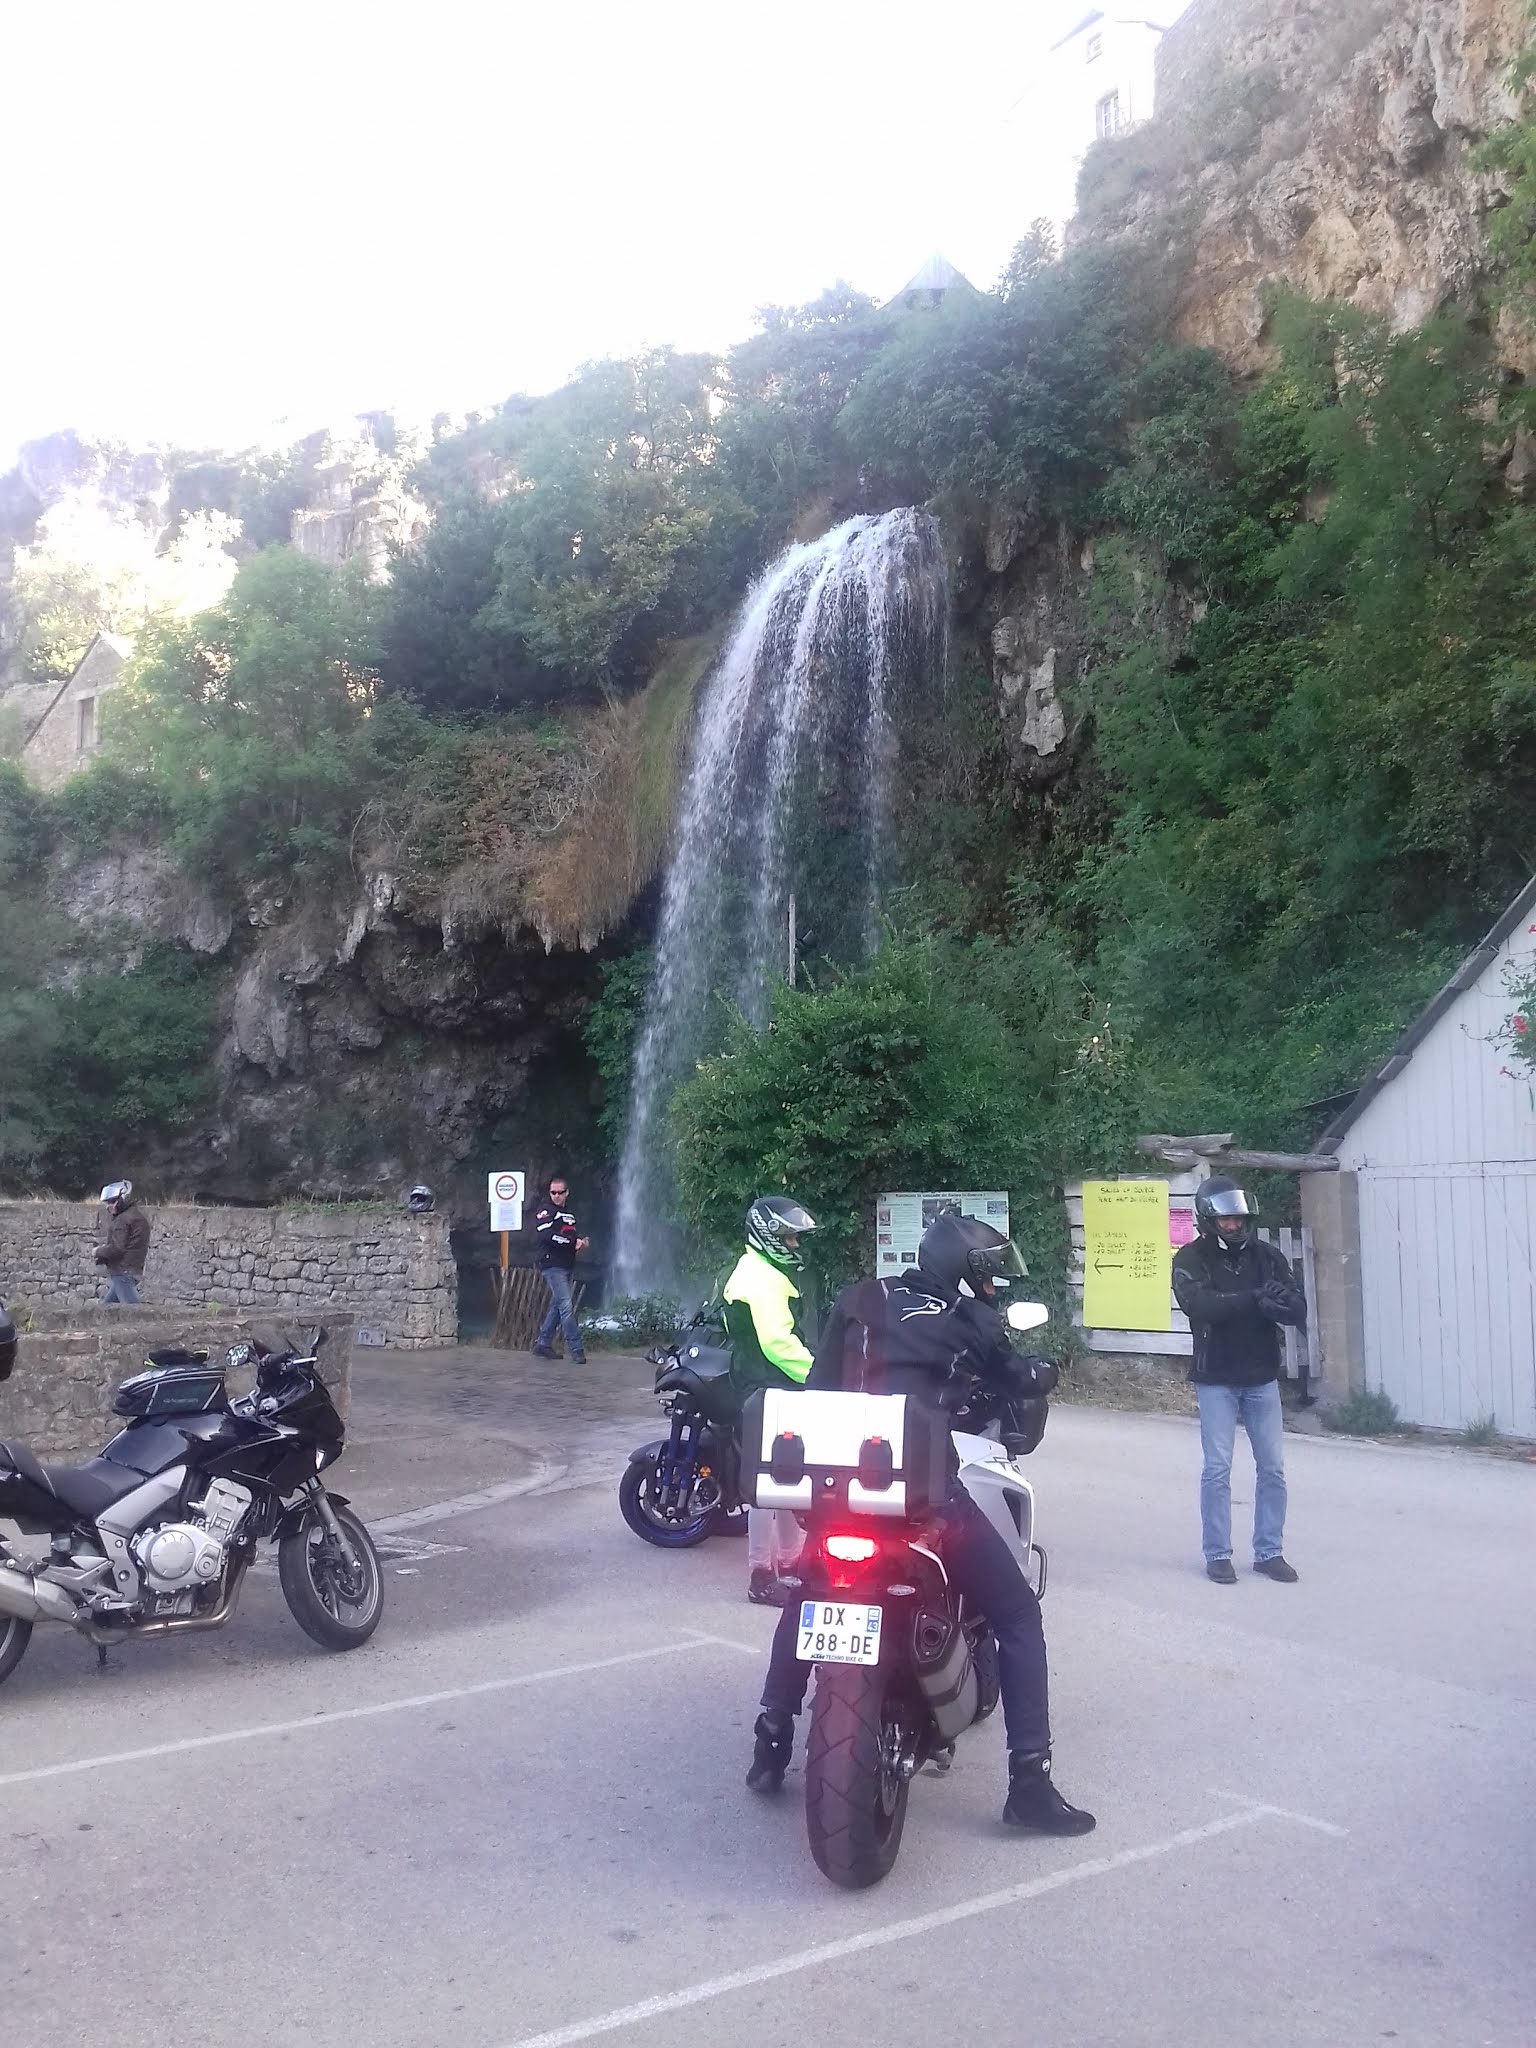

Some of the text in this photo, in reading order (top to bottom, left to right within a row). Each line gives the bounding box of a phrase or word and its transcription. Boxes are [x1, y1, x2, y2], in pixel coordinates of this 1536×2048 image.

[823, 1607, 845, 1626] DX
[868, 1621, 878, 1632] 43
[803, 1632, 873, 1655] 788-DE
